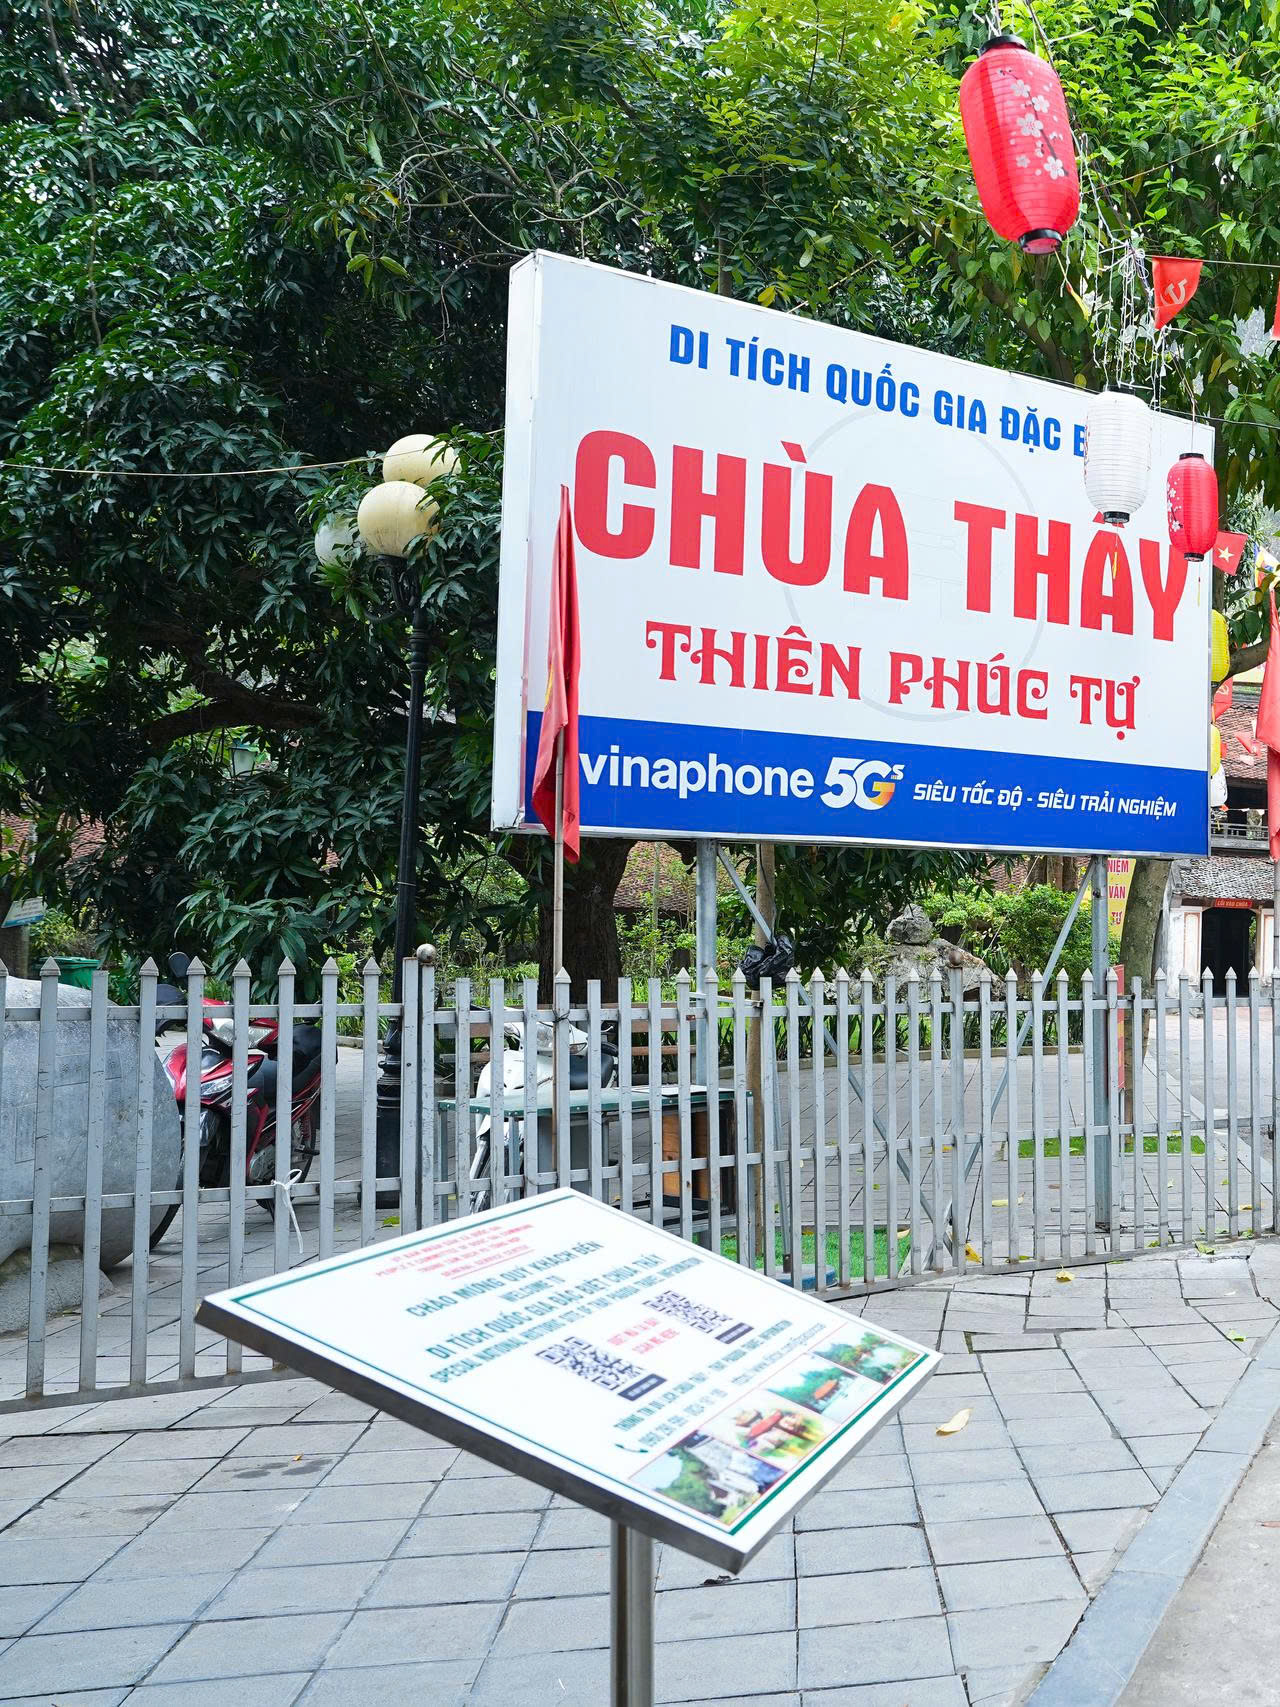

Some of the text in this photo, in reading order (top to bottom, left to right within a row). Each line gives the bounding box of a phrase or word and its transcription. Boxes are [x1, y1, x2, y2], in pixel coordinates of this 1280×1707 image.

[670, 324, 709, 370] DI
[726, 337, 810, 393] TÍCH
[826, 363, 919, 417] QUỐC
[934, 390, 987, 434] GIA
[1000, 406, 1061, 452] ĐẶC
[574, 430, 909, 600] CHÙA
[646, 620, 1140, 740] THIÊN PHÚC TỰ
[579, 744, 814, 799] vinaphone
[913, 780, 956, 801] SIÊU
[962, 780, 994, 805] TỐC
[997, 786, 1023, 811] ĐỘ
[1037, 788, 1075, 810] SIÊU
[1080, 791, 1114, 813] TRẢI
[1117, 796, 1177, 821] NGHIỆM
[1109, 884, 1126, 899] VĂN
[406, 1296, 458, 1317] CHÀO
[425, 1344, 456, 1359] DI
[445, 1328, 494, 1349] TÍCH
[524, 1301, 558, 1316] GIA
[430, 1359, 482, 1383] SPECIAL
